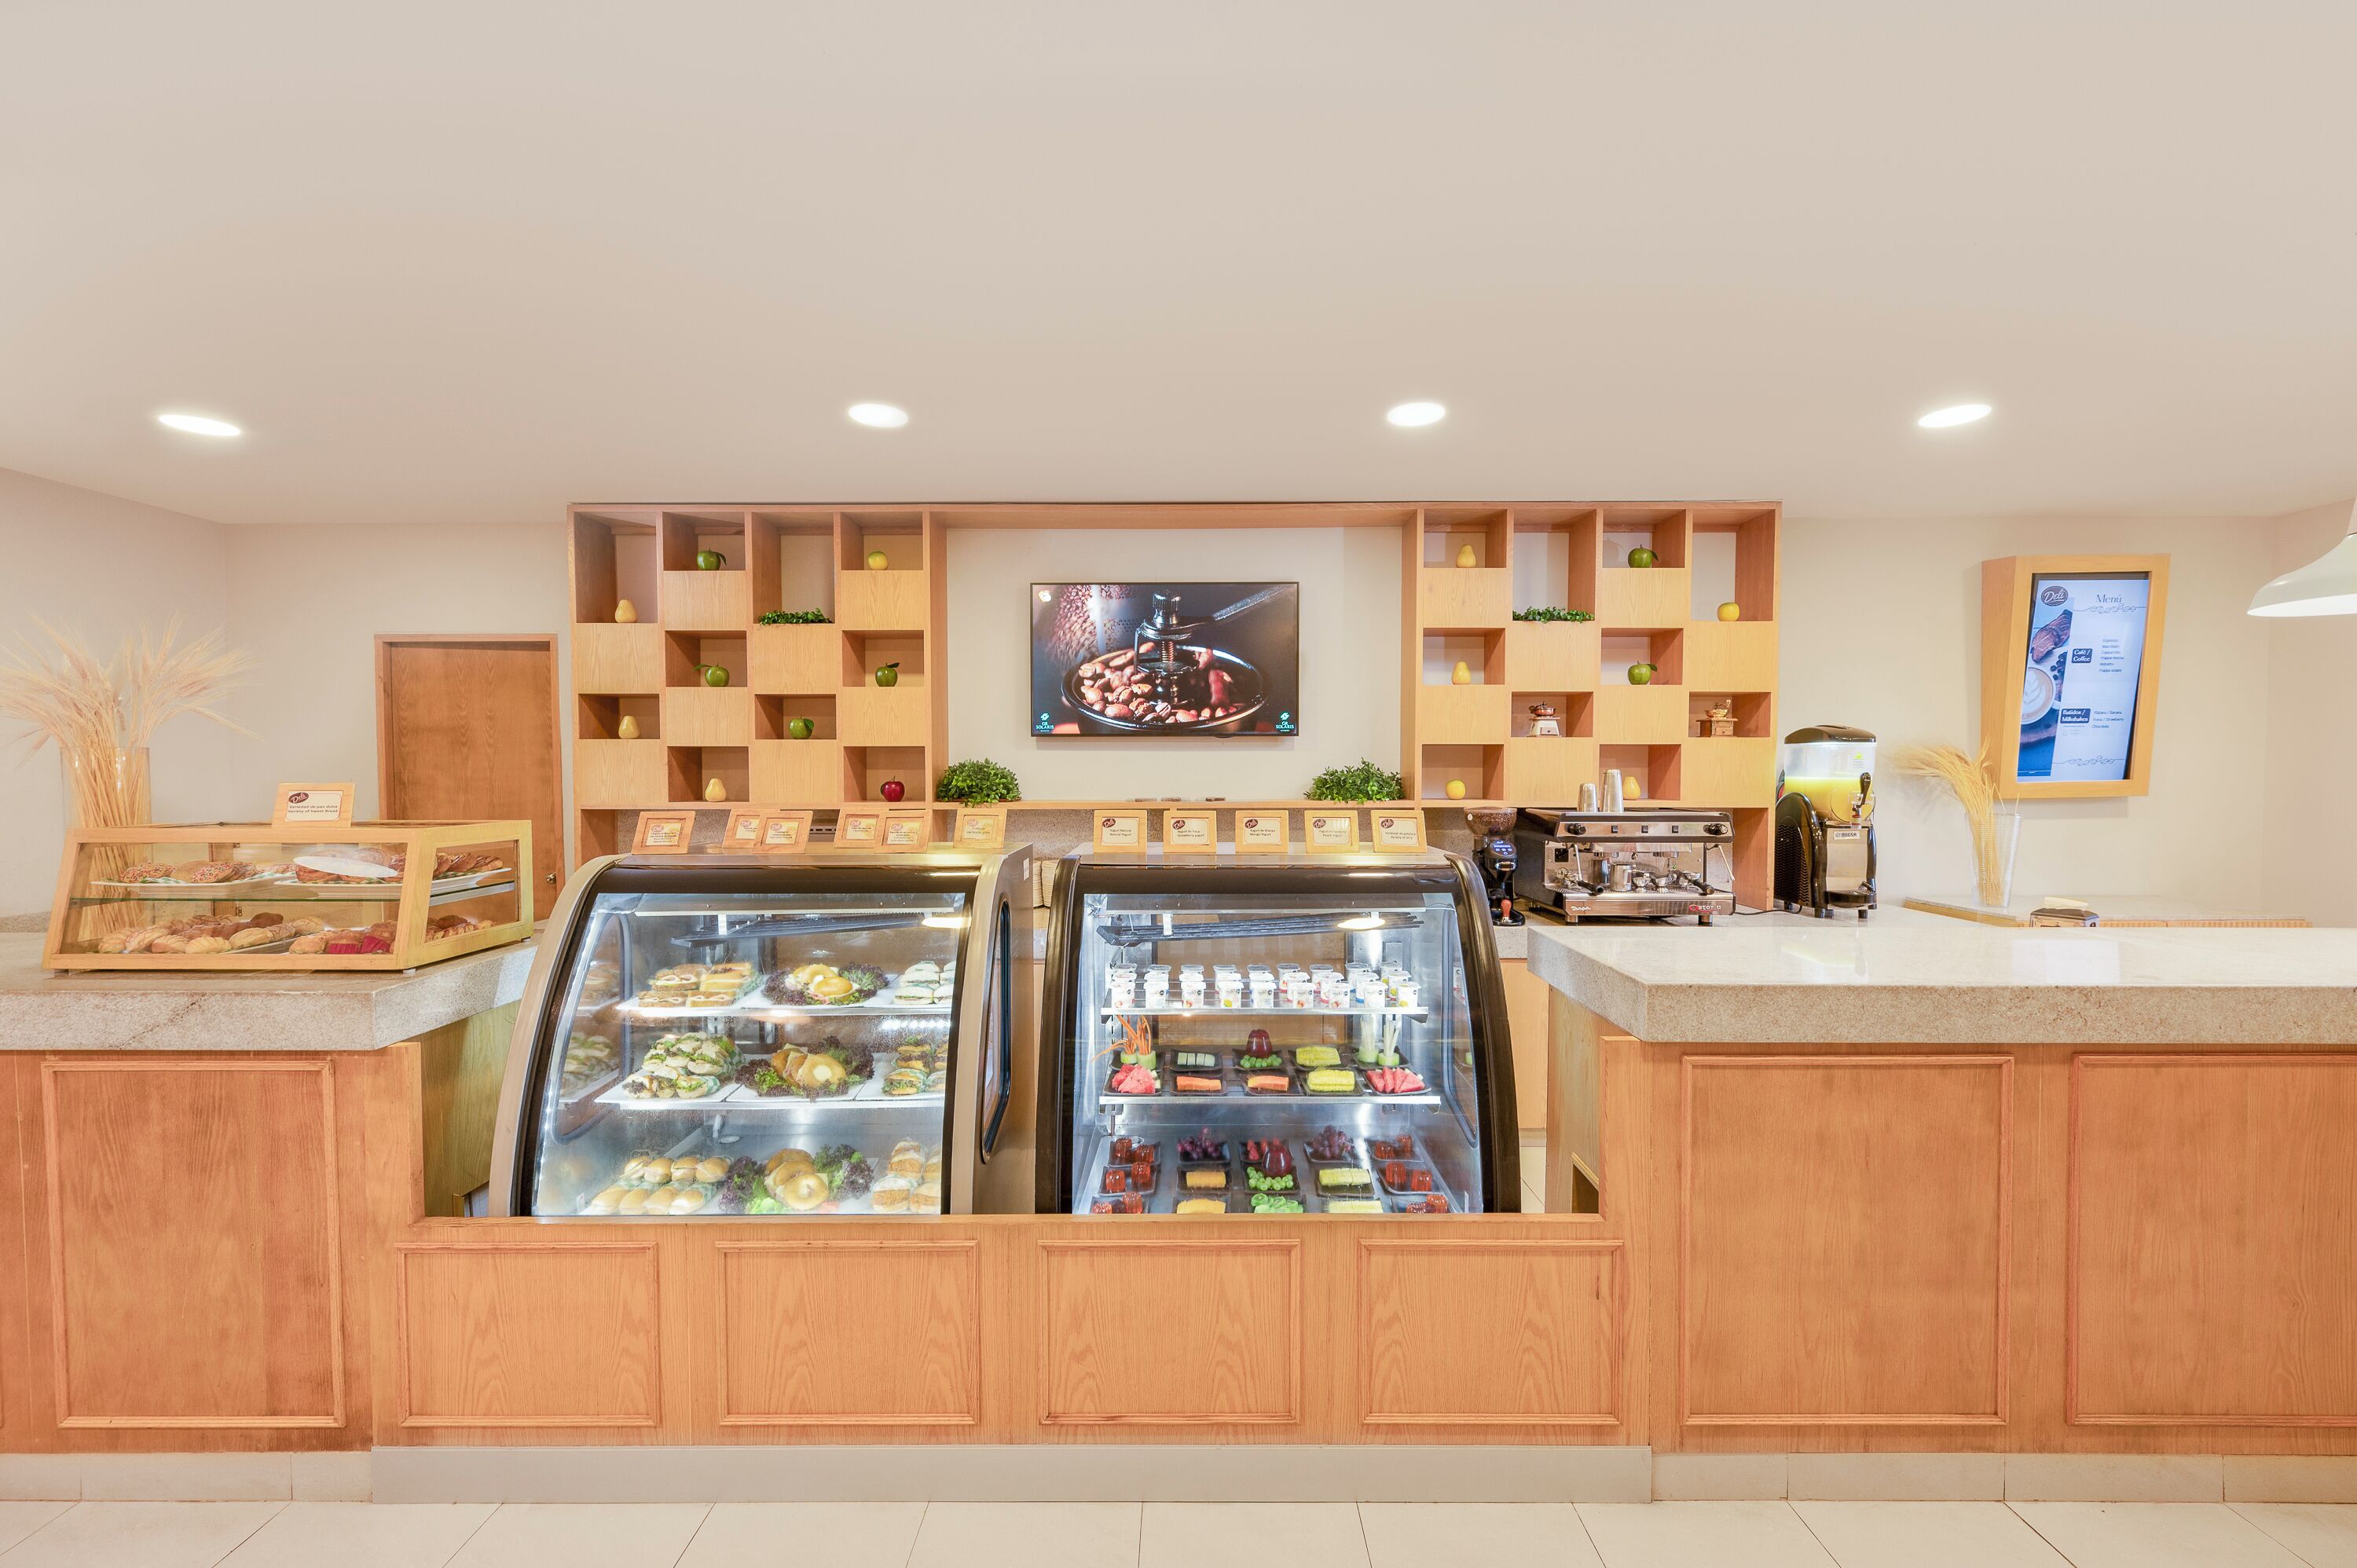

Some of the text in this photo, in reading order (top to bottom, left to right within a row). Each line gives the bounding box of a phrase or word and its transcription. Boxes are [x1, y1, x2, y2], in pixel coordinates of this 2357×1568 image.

[2044, 588, 2066, 603] Deli
[2096, 594, 2122, 603] Menú
[290, 792, 308, 803] Deli
[1103, 818, 1115, 828] Deli
[1173, 819, 1185, 830] Deli
[1246, 819, 1258, 828] Deli
